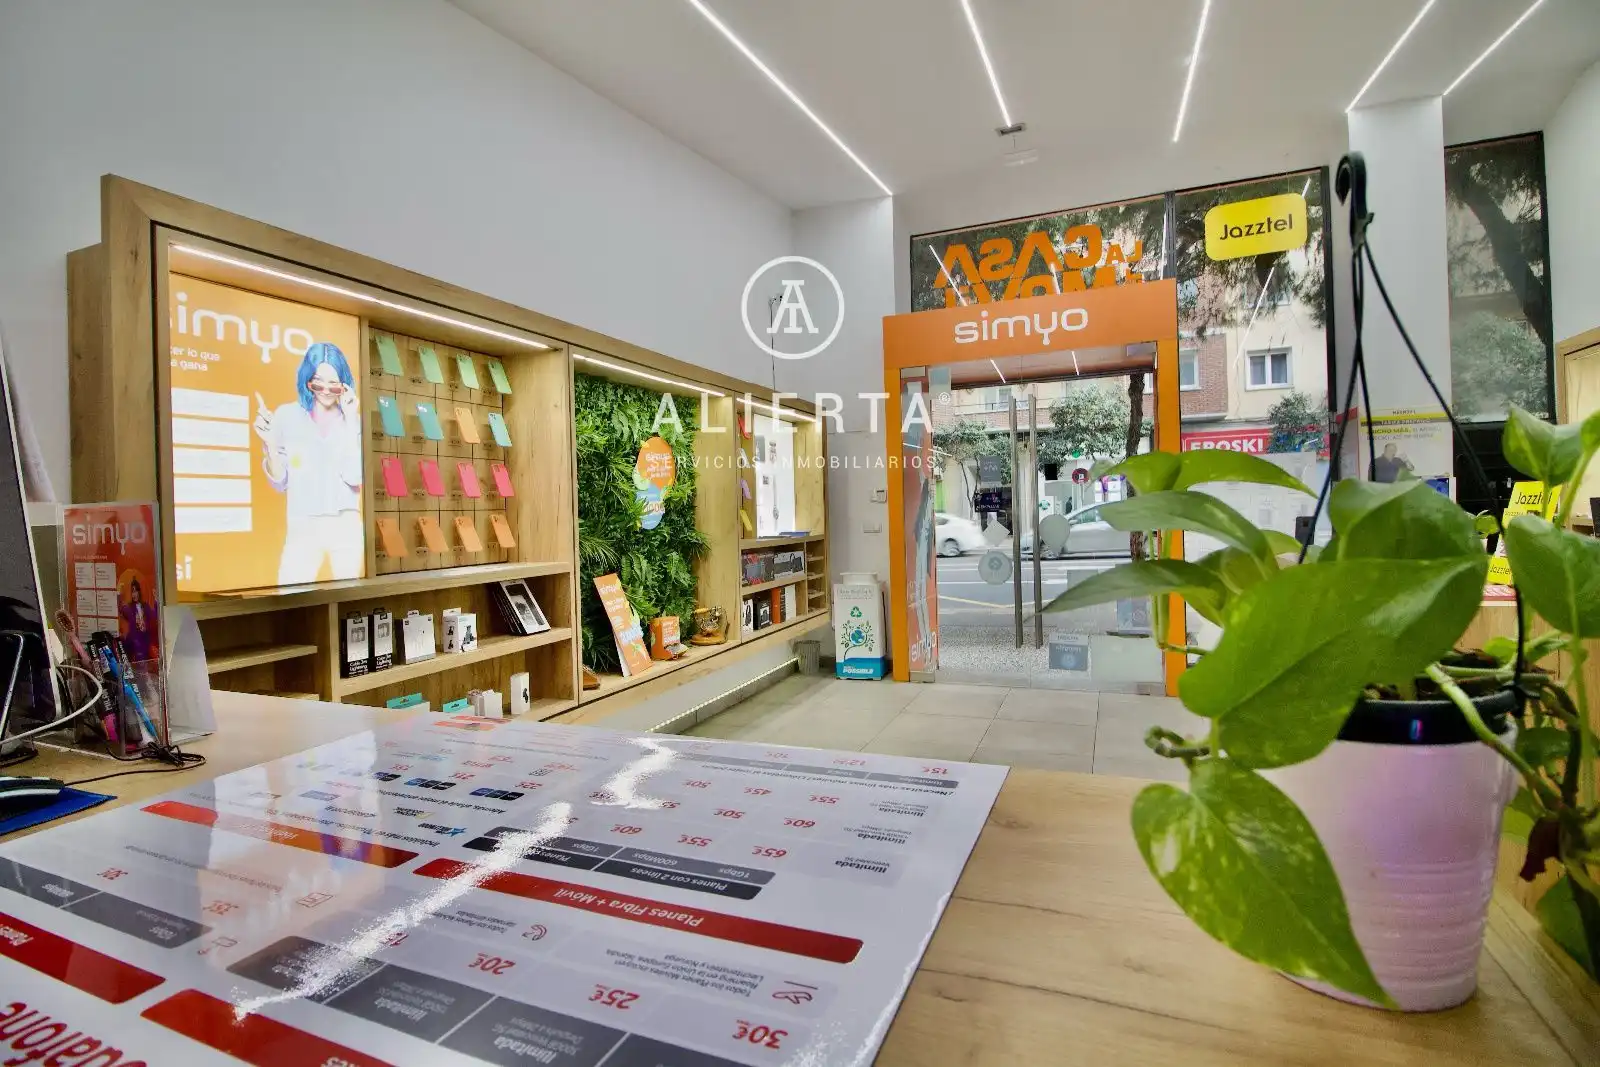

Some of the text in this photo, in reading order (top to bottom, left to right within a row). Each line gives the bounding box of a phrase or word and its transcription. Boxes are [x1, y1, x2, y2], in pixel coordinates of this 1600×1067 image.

[1219, 213, 1293, 241] Jazztel
[169, 292, 314, 364] imyo
[955, 307, 1089, 346] simyo
[1515, 491, 1552, 505] Jazztl
[72, 513, 147, 556] simyo
[804, 794, 841, 804] 55€
[709, 808, 747, 818] 50€
[879, 806, 925, 818] Ilimitada
[780, 817, 818, 828] 60€
[610, 825, 643, 835] 60€
[677, 834, 713, 847] 55€
[857, 832, 906, 845] Ilimitada
[751, 846, 787, 859] 65€
[631, 866, 658, 879] líneas
[717, 867, 751, 879] 1Gbps
[834, 859, 888, 874] Ilimitada
[672, 875, 691, 884] con
[692, 878, 728, 891] Planes
[553, 888, 598, 905] Móvil
[610, 899, 648, 916] Fibra
[651, 907, 704, 927] Planes
[468, 956, 516, 975] 20€
[587, 988, 641, 1010] 25€
[732, 1024, 789, 1050] 30€
[493, 1036, 557, 1062] Ilimitada
